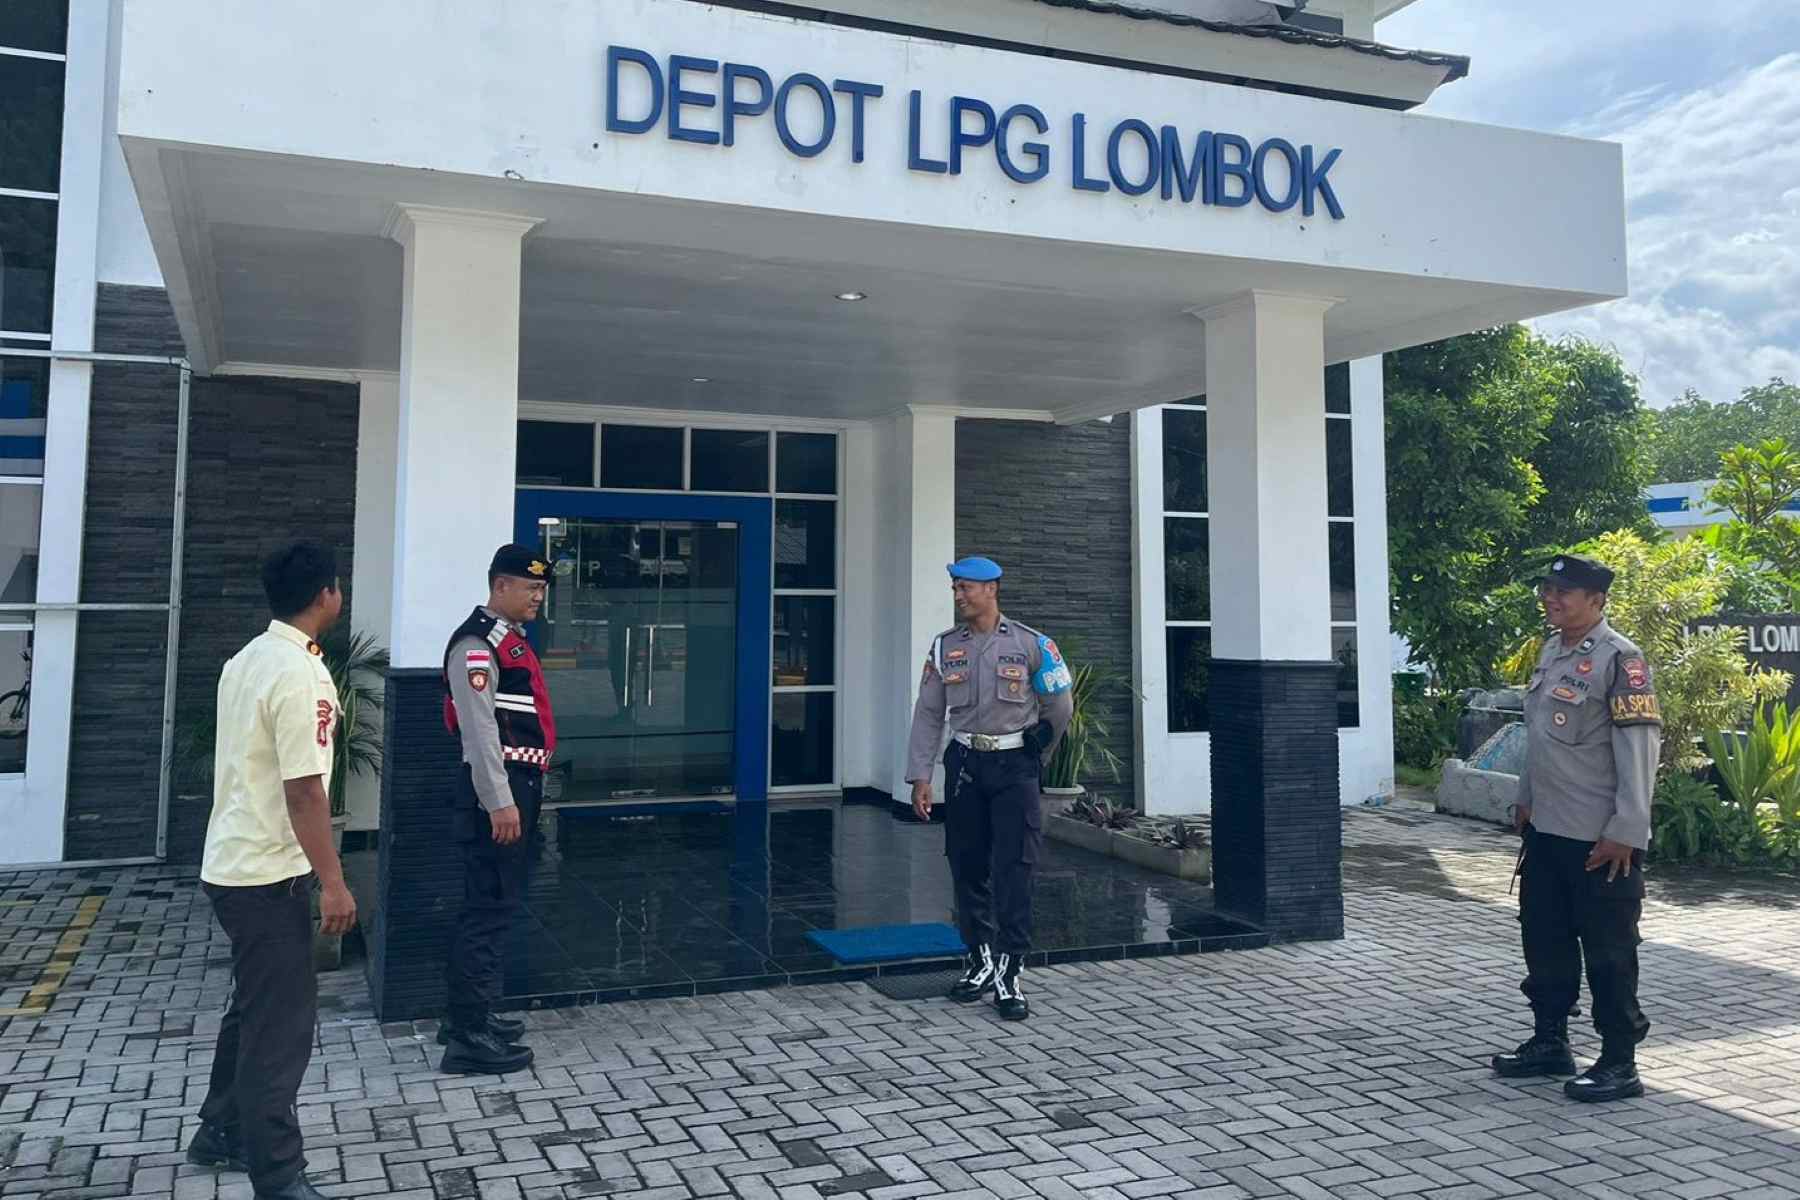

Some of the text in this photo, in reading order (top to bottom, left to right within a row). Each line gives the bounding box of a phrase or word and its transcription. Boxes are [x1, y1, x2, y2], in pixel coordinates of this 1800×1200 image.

[606, 45, 1345, 220] DEPOT LPG LOMBOK
[1560, 673, 1591, 692] POLRI
